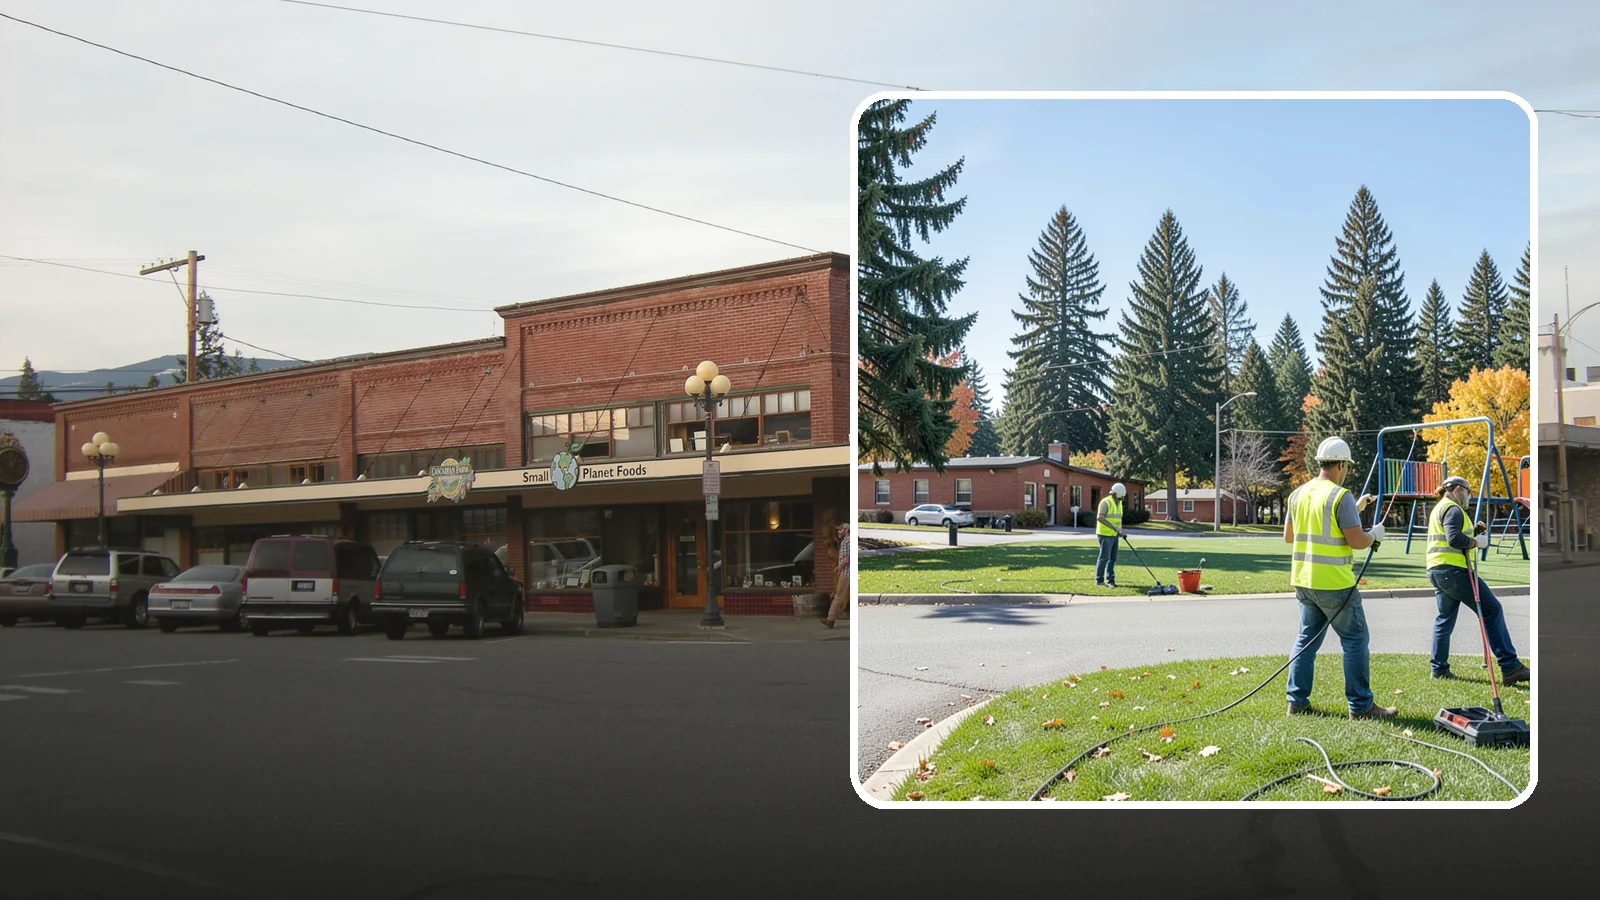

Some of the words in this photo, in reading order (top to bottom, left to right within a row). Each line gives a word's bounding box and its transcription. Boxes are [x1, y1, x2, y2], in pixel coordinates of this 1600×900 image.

[523, 471, 549, 483] Small
[583, 467, 614, 479] Planet
[617, 464, 647, 477] Foods
